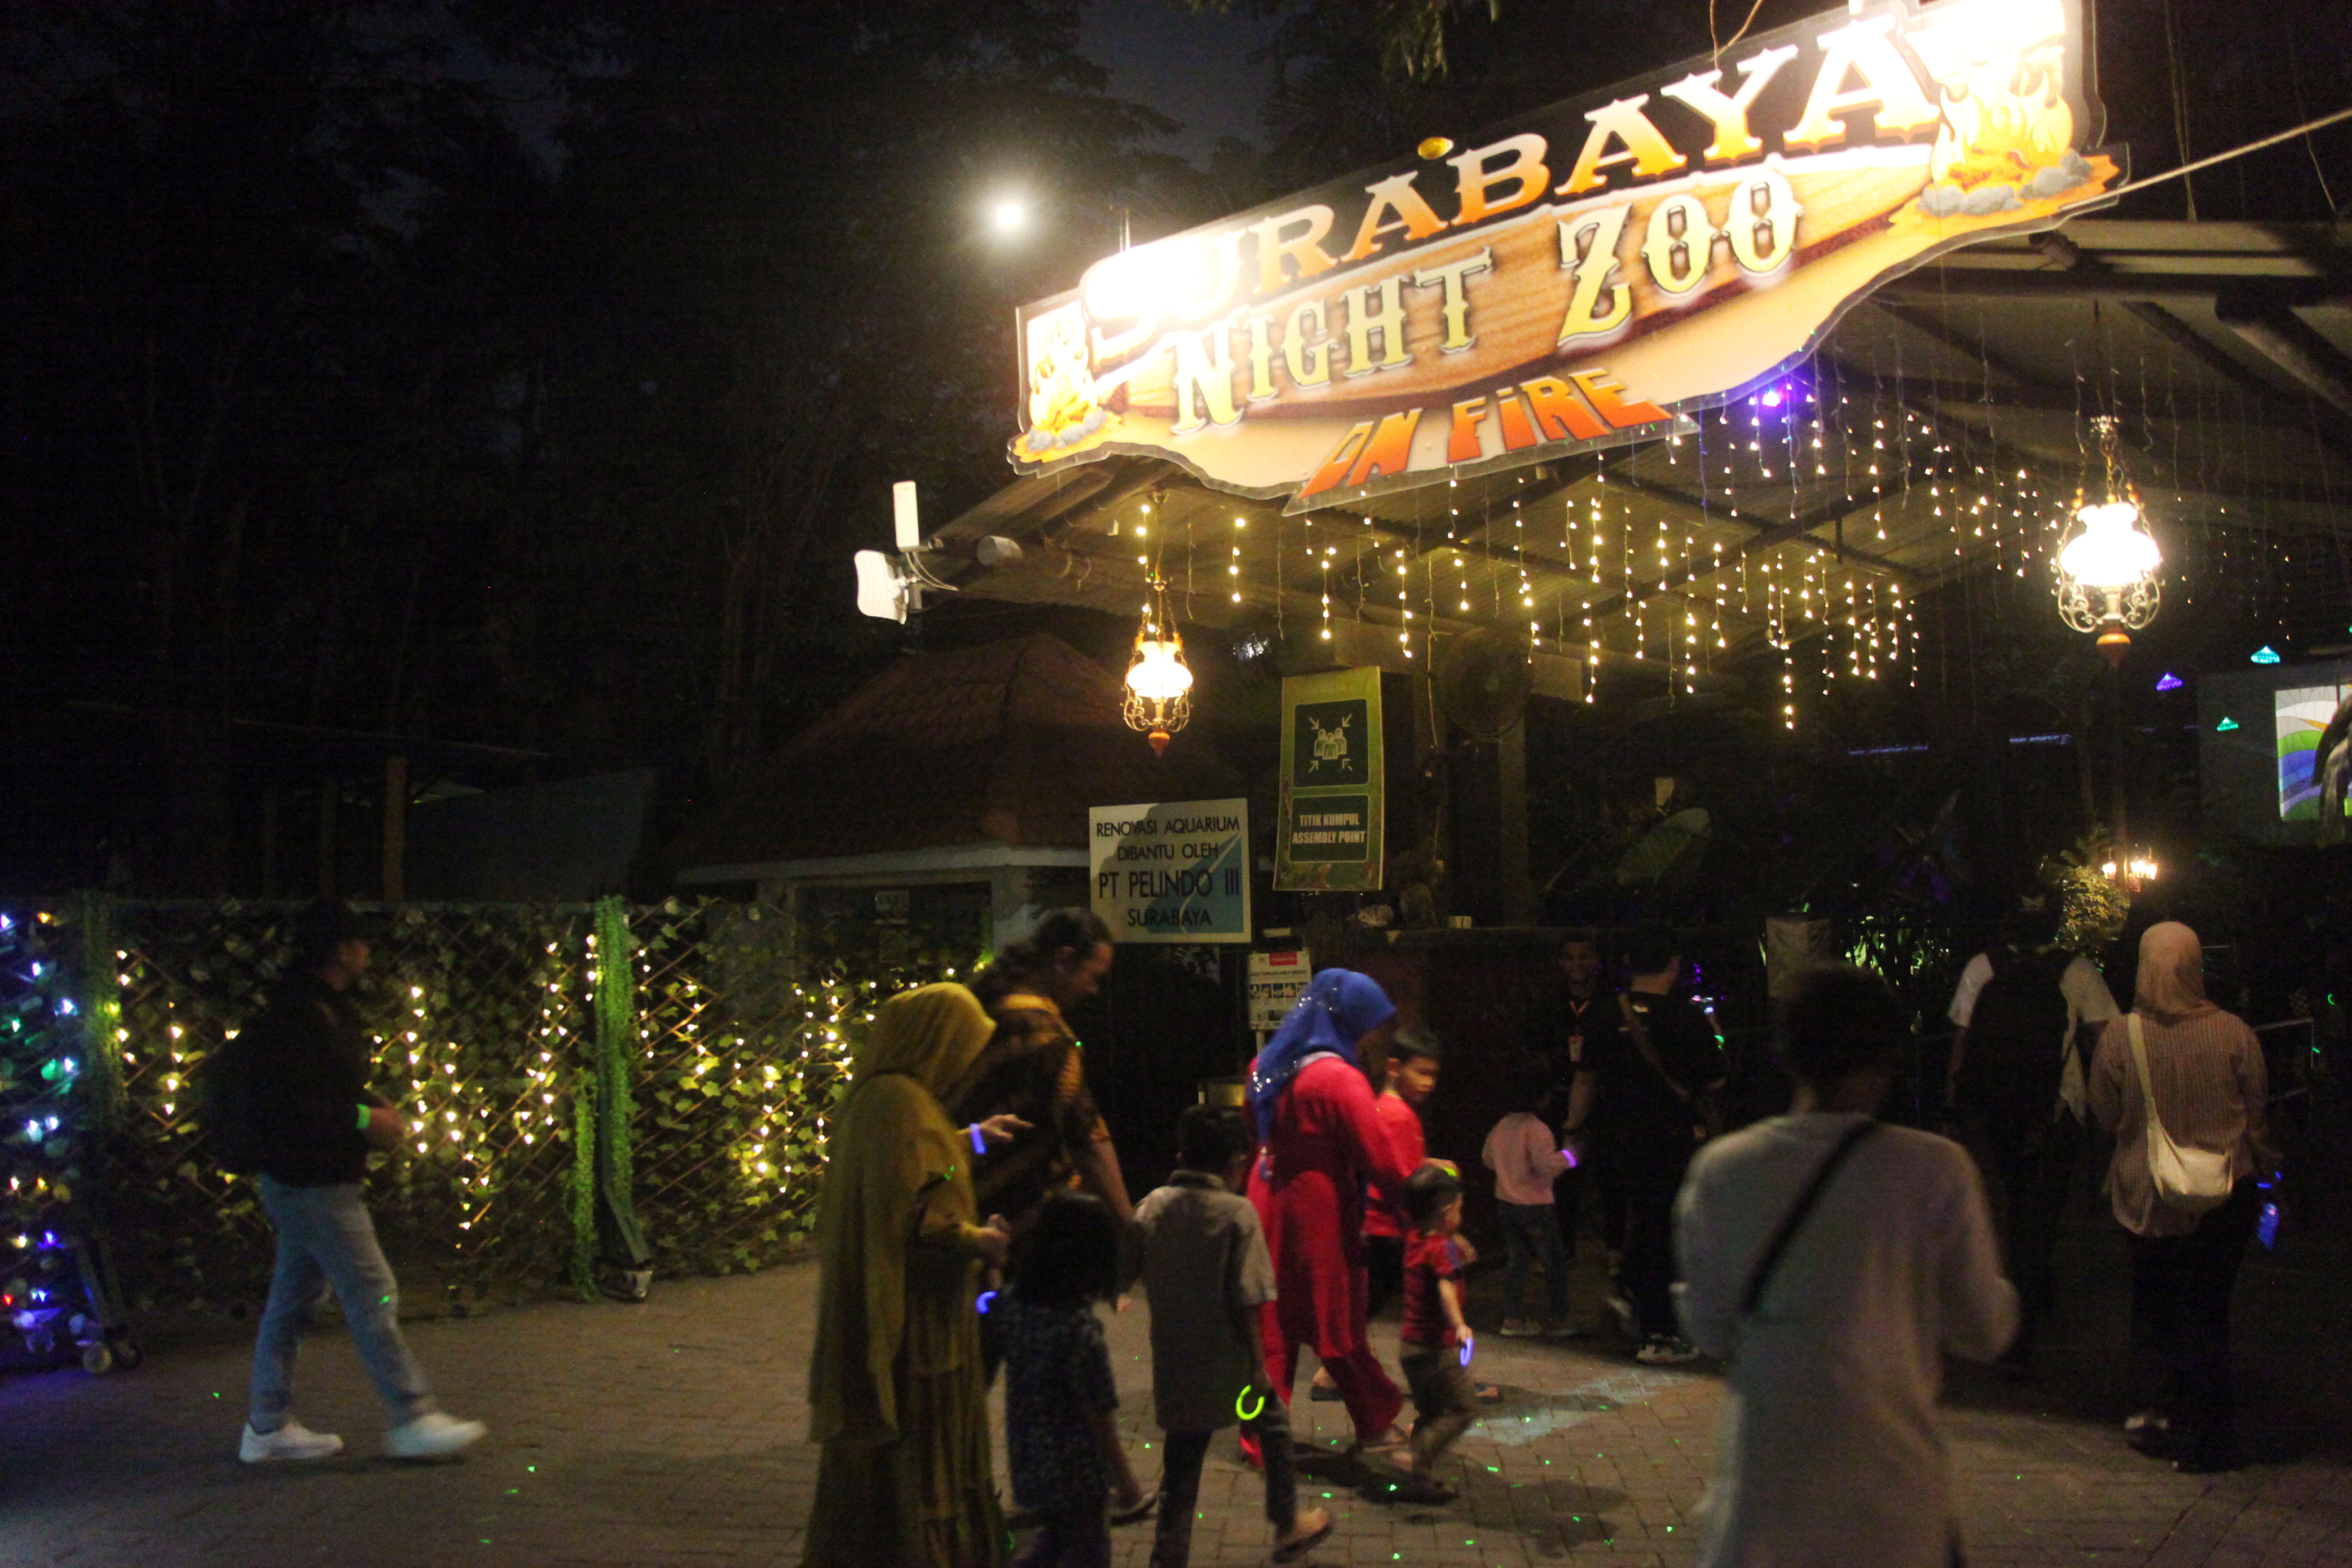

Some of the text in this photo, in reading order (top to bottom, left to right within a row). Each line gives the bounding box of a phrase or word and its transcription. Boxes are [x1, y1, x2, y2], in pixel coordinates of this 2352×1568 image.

[1170, 171, 1803, 435] NIGHT ZOO
[1298, 408, 1424, 500] ON
[1097, 816, 1240, 837] RENOVASI AQUARIUM
[1299, 813, 1360, 827] TITIK KUMPUL
[1292, 831, 1365, 844] ASSEMBLY POINT
[1117, 843, 1218, 861] DIBANTU OLEH
[1099, 868, 1240, 898] PT PELINDO III
[1127, 908, 1213, 927] SURABAYA
